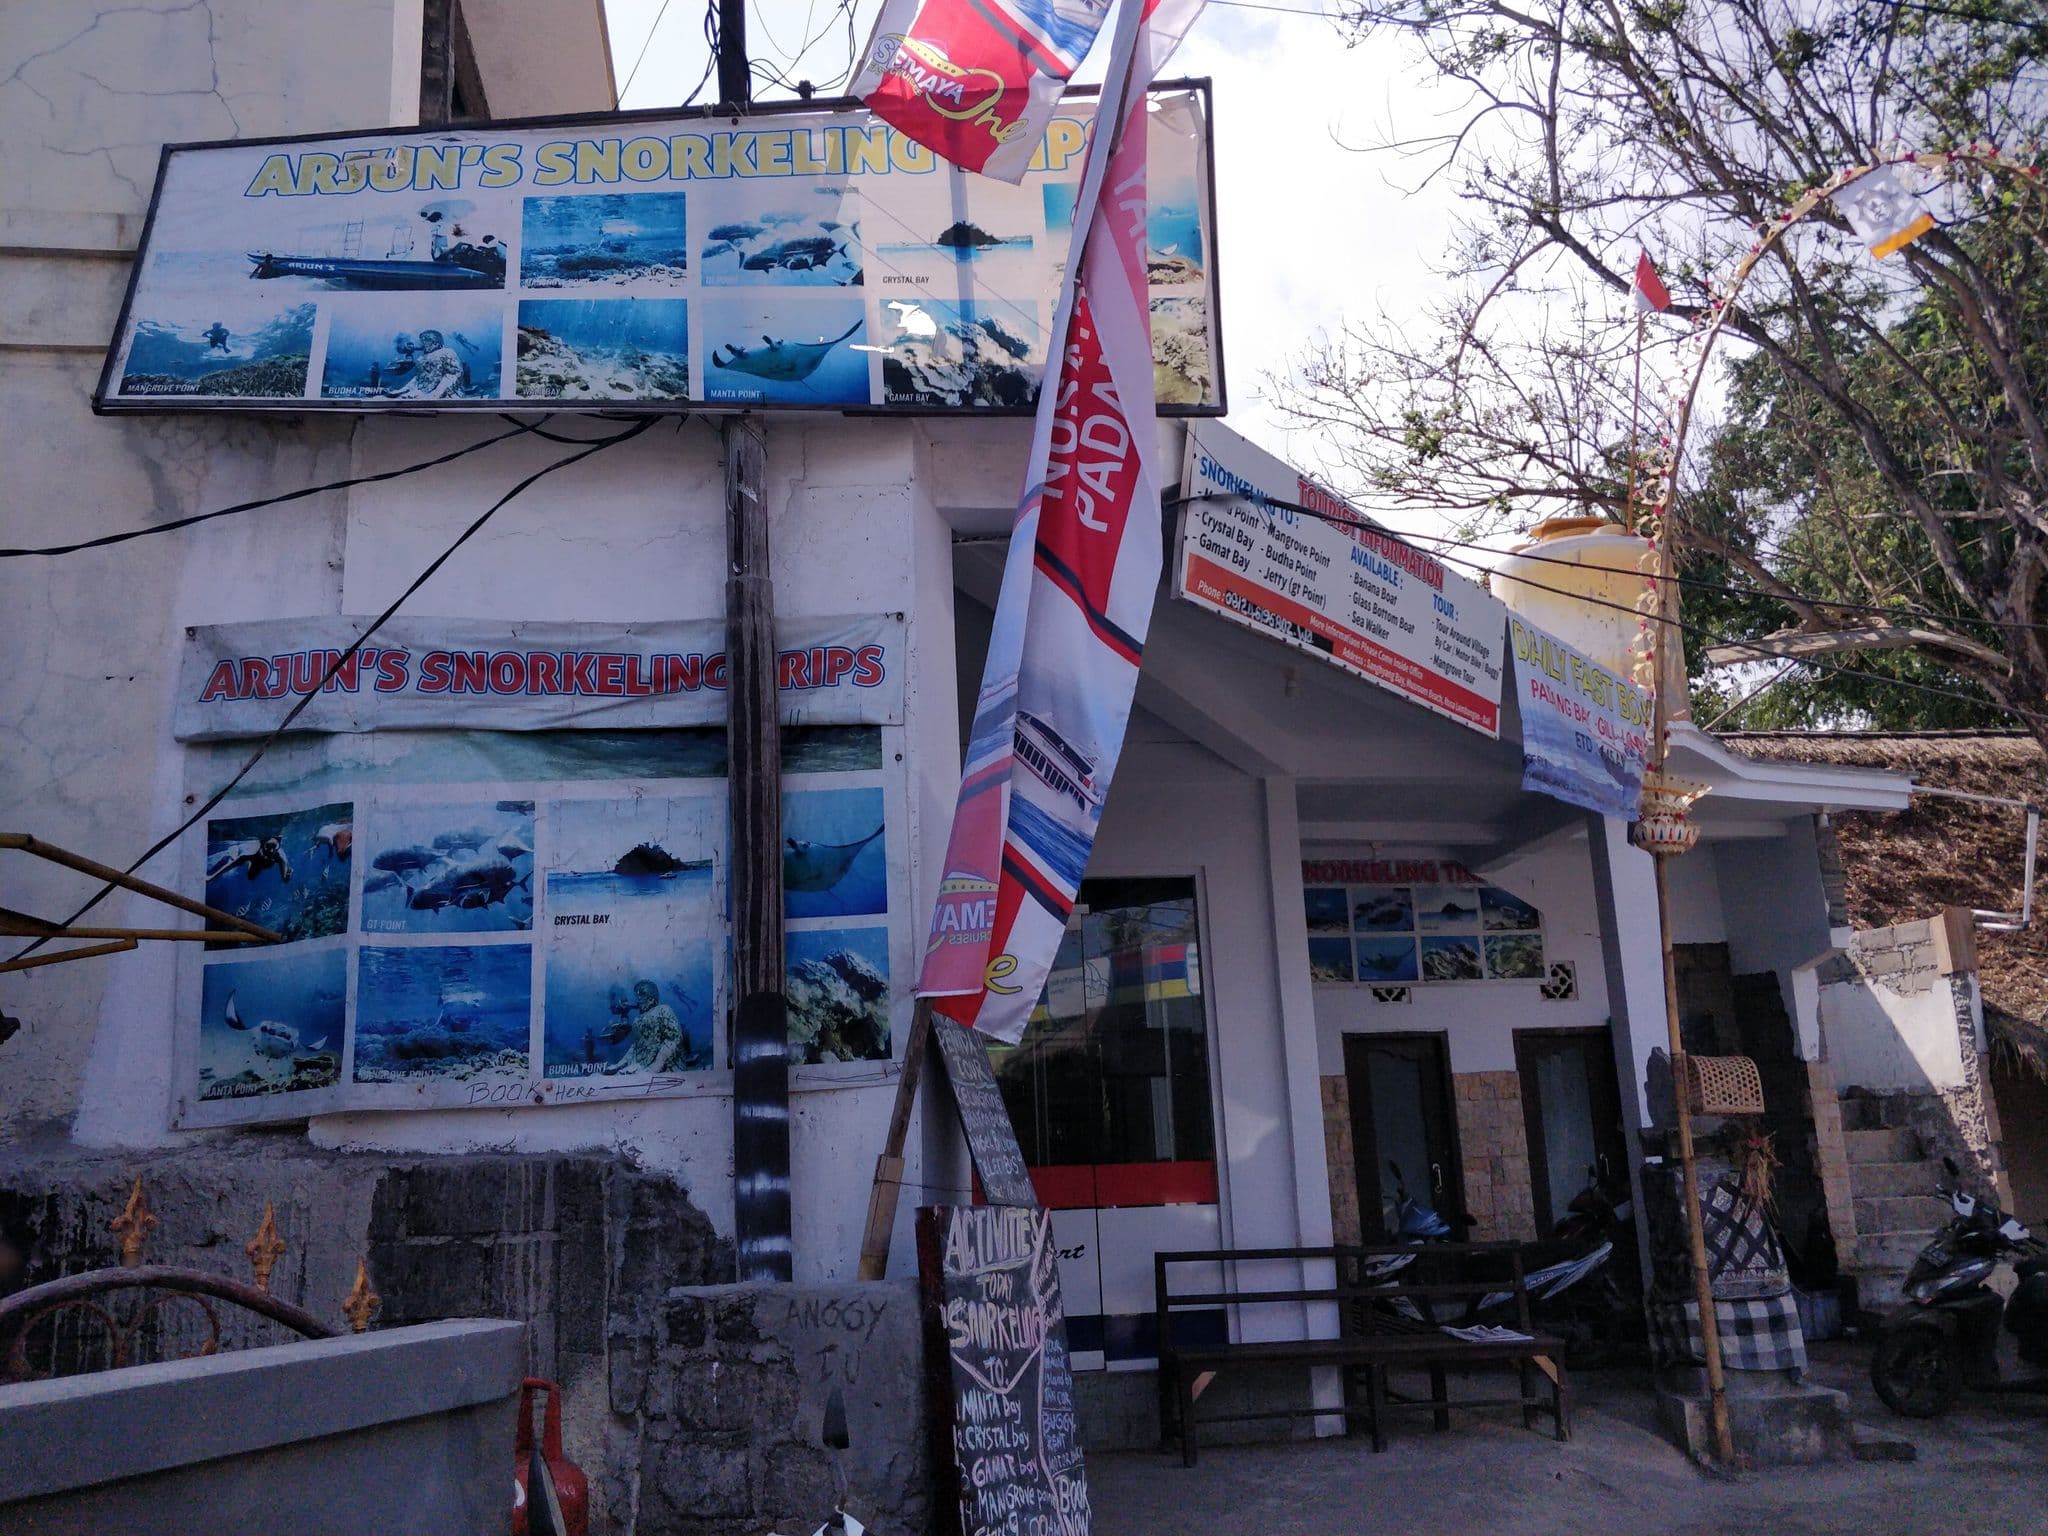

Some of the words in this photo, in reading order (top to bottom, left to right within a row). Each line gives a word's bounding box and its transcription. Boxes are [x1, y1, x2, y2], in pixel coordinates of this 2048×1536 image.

[245, 143, 523, 197] ARJUN'S
[534, 126, 937, 188] SNORKELING
[883, 276, 913, 284] CRYSTAL
[915, 276, 929, 284] BAY
[328, 386, 357, 395] BUDHA
[710, 389, 737, 398] MANTA
[738, 389, 761, 399] POINT
[889, 393, 913, 402] GAMAT
[915, 394, 929, 402] BAY
[1201, 511, 1235, 541] Crystal
[1236, 529, 1255, 550] Bay
[1235, 506, 1259, 529] Point
[1267, 523, 1308, 556] Mangrove
[1309, 547, 1331, 568] Point
[1297, 479, 1360, 540] TOURIST
[1359, 528, 1445, 593] INFORMATION
[1199, 533, 1230, 560] Gamat
[1231, 551, 1250, 572] Bay
[1265, 545, 1294, 569] Budha
[1295, 560, 1317, 582] Point
[1351, 546, 1399, 587] AVAILABLE
[1302, 583, 1327, 611] Point)
[1353, 572, 1381, 597] Banana
[1381, 588, 1398, 606] Boat
[1352, 592, 1372, 613] Glass
[1372, 602, 1399, 627] Bottom
[1399, 617, 1415, 635] Boat
[1432, 594, 1455, 619] TOUR
[1351, 611, 1365, 628] Sea
[1365, 618, 1390, 641] Walker
[1435, 618, 1449, 636] Tour
[1449, 627, 1472, 647] Around
[199, 648, 410, 701] ARJUN'S
[417, 649, 728, 696] SNORKELING
[778, 644, 886, 691] RIPS
[1432, 653, 1462, 679] Mangrove
[1462, 669, 1476, 685] Tour
[1513, 622, 1566, 685] DAILY
[1570, 654, 1614, 712] FAST
[379, 919, 407, 929] POINT
[554, 915, 591, 926] CRYSTAL
[592, 914, 610, 925] BAY
[549, 1064, 579, 1075] BUDHA
[581, 1062, 607, 1073] POINT
[466, 1081, 541, 1105] BOOK
[965, 1425, 1012, 1451] CRYSTAL
